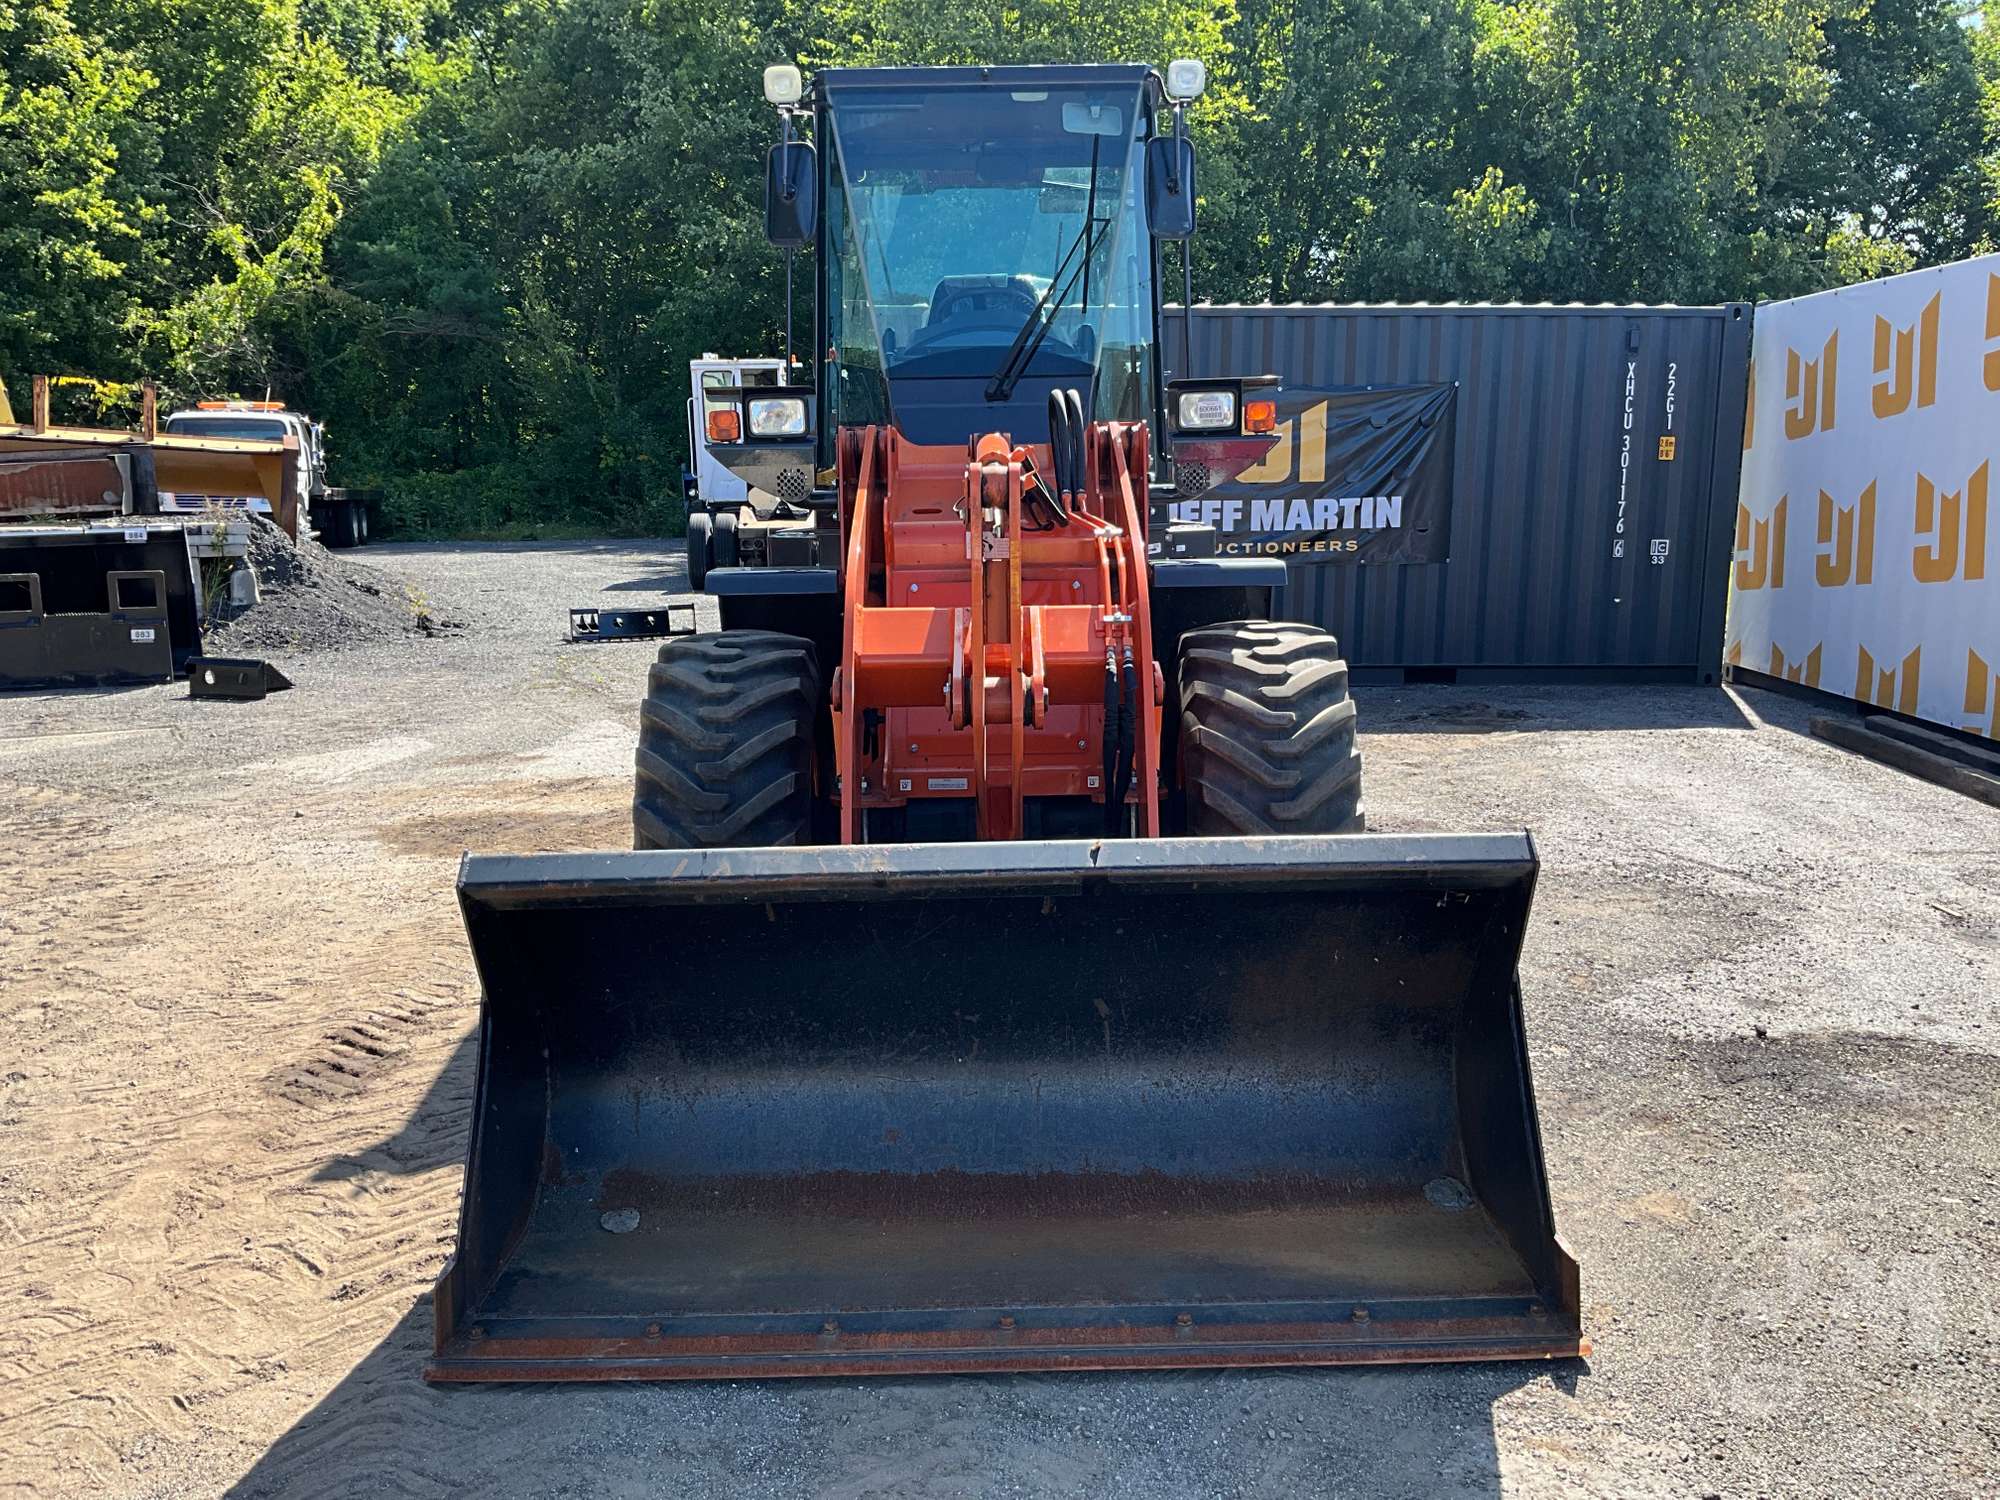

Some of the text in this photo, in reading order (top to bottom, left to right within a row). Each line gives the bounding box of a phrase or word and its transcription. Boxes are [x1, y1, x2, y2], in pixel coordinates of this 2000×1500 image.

[1624, 362, 1635, 429] XHCU
[1666, 363, 1677, 430] 22G1
[1616, 435, 1630, 534] 301176
[1250, 496, 1402, 531] MARTIN
[1215, 540, 1358, 553] UCTIONEERS
[1651, 555, 1665, 565] 33
